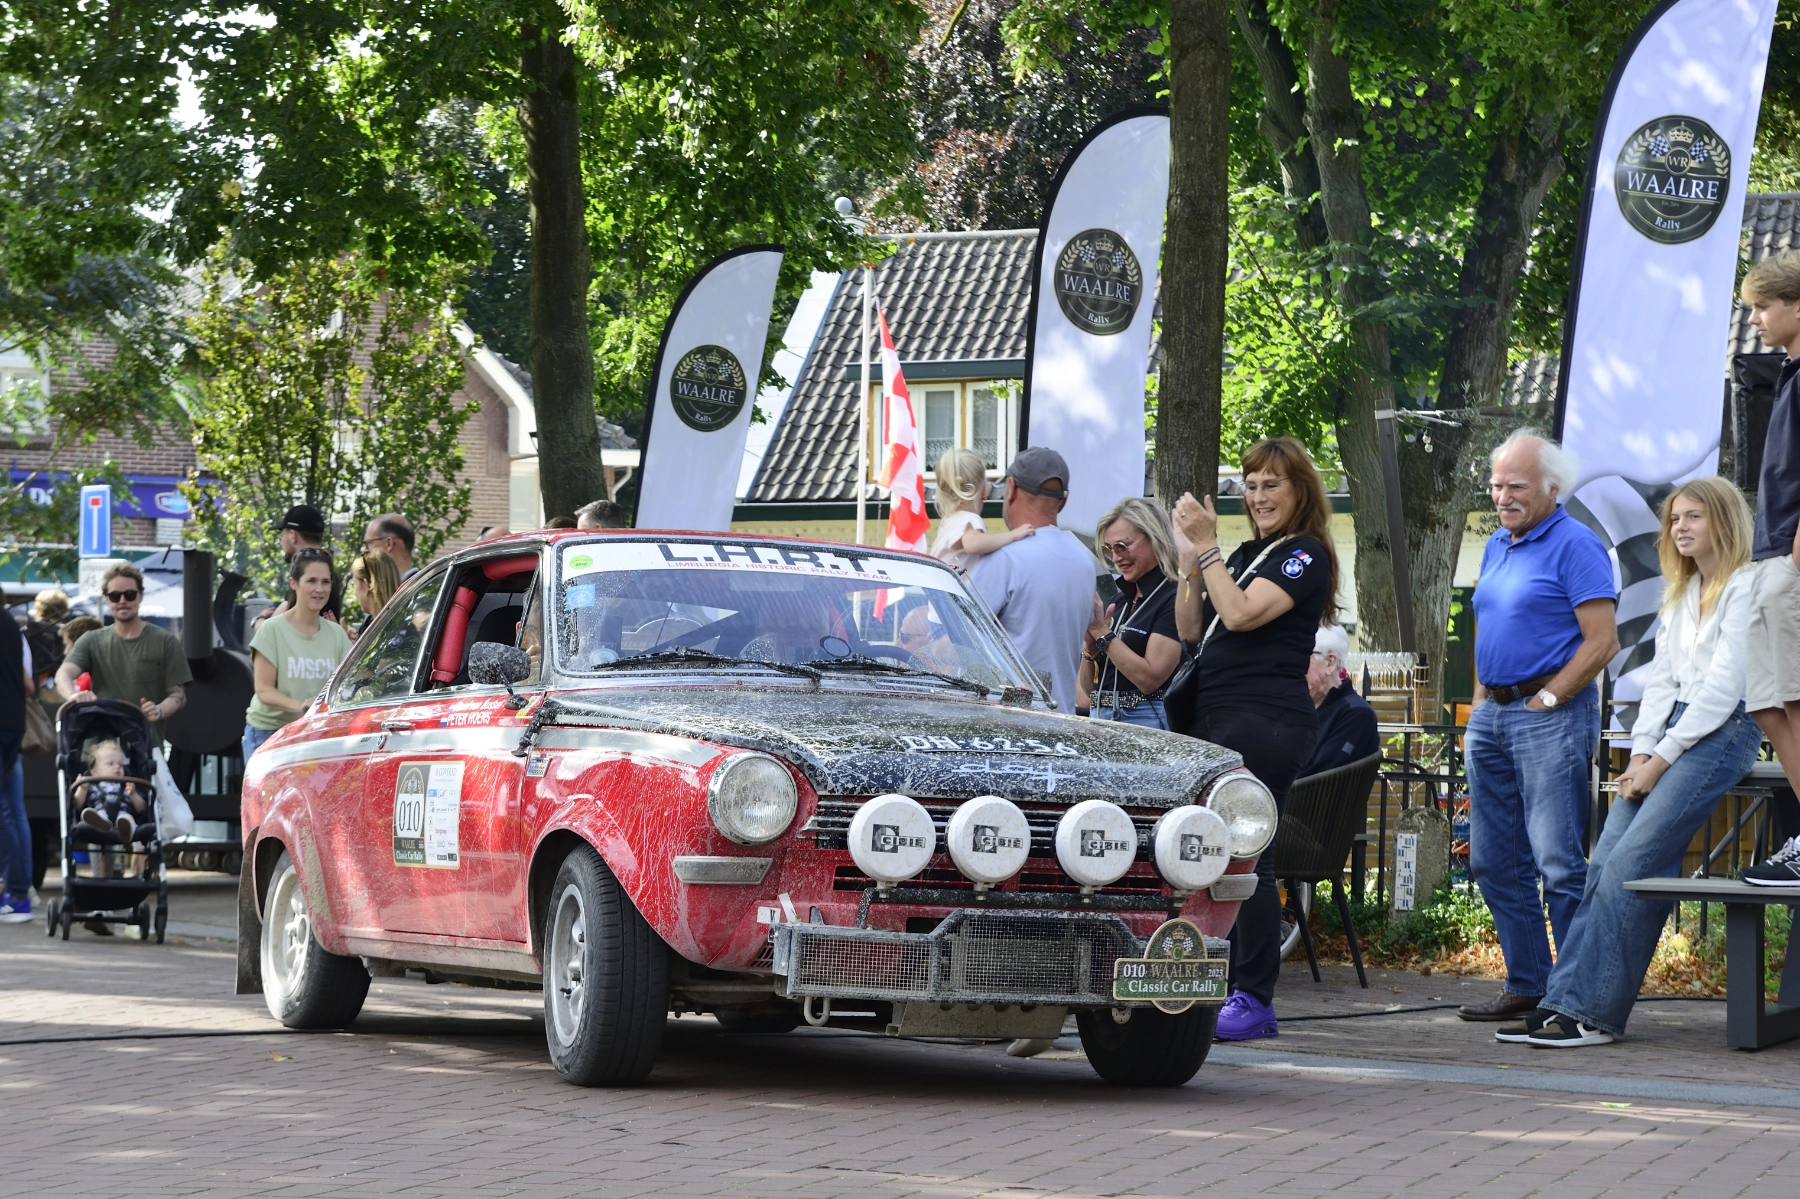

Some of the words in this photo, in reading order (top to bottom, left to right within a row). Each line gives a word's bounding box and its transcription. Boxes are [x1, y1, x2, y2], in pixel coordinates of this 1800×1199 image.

[1627, 170, 1719, 200] WAALRE
[1655, 216, 1680, 231] Rally
[1063, 274, 1130, 301] WAALRE
[1087, 312, 1110, 325] Rally
[678, 382, 736, 404] WAALRE
[745, 564, 806, 572] HISTORIC
[811, 568, 849, 576] RALLY
[855, 572, 892, 581] TEAM
[287, 656, 336, 680] MSCH
[447, 712, 468, 726] PETER
[399, 800, 420, 832] 010
[882, 836, 924, 848] CIBIE
[1090, 840, 1129, 851] CIBIE
[1188, 845, 1224, 857] CIBIE
[1123, 964, 1145, 978] 010
[1151, 964, 1198, 978] WAALRE
[1208, 969, 1224, 978] 2023
[1128, 980, 1168, 993] Classic
[1171, 980, 1189, 993] Car
[1192, 980, 1218, 996] Rally
